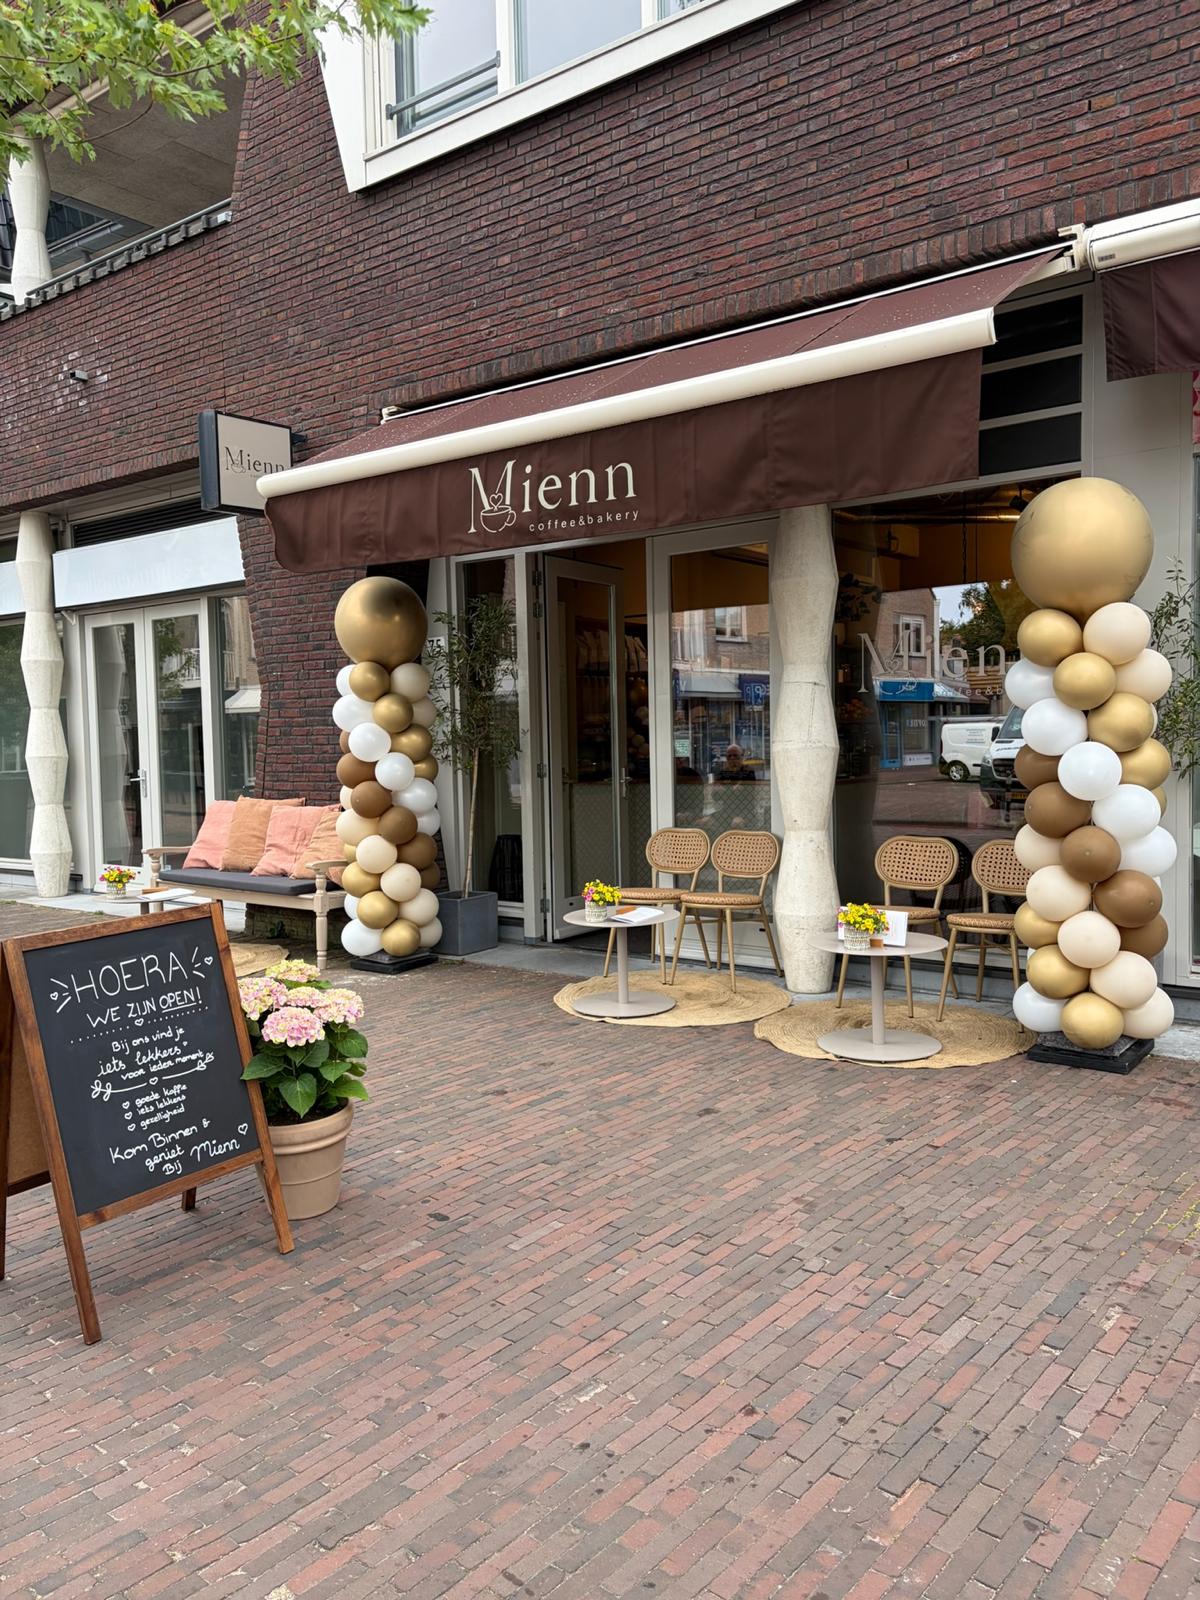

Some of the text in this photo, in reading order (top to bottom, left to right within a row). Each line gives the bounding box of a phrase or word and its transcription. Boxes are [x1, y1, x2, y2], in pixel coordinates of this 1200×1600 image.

[468, 459, 637, 533] Mienn
[528, 510, 639, 532] coffee&bakery
[857, 630, 1024, 694] Mien
[70, 951, 188, 1003] HOERA
[86, 986, 202, 1028] WE ZIJN OPEN!
[112, 1025, 185, 1055] Bij ons vind je
[97, 1046, 182, 1077] iets lekkers
[121, 1049, 204, 1080] voor ieder moment
[135, 1084, 188, 1107] goede koffie
[137, 1094, 186, 1115] iets lekkers
[140, 1103, 185, 1130] gezelligheid
[109, 1118, 211, 1164] Kom Binnen &
[190, 1139, 240, 1162] Mienn
[145, 1144, 185, 1172] geniet
